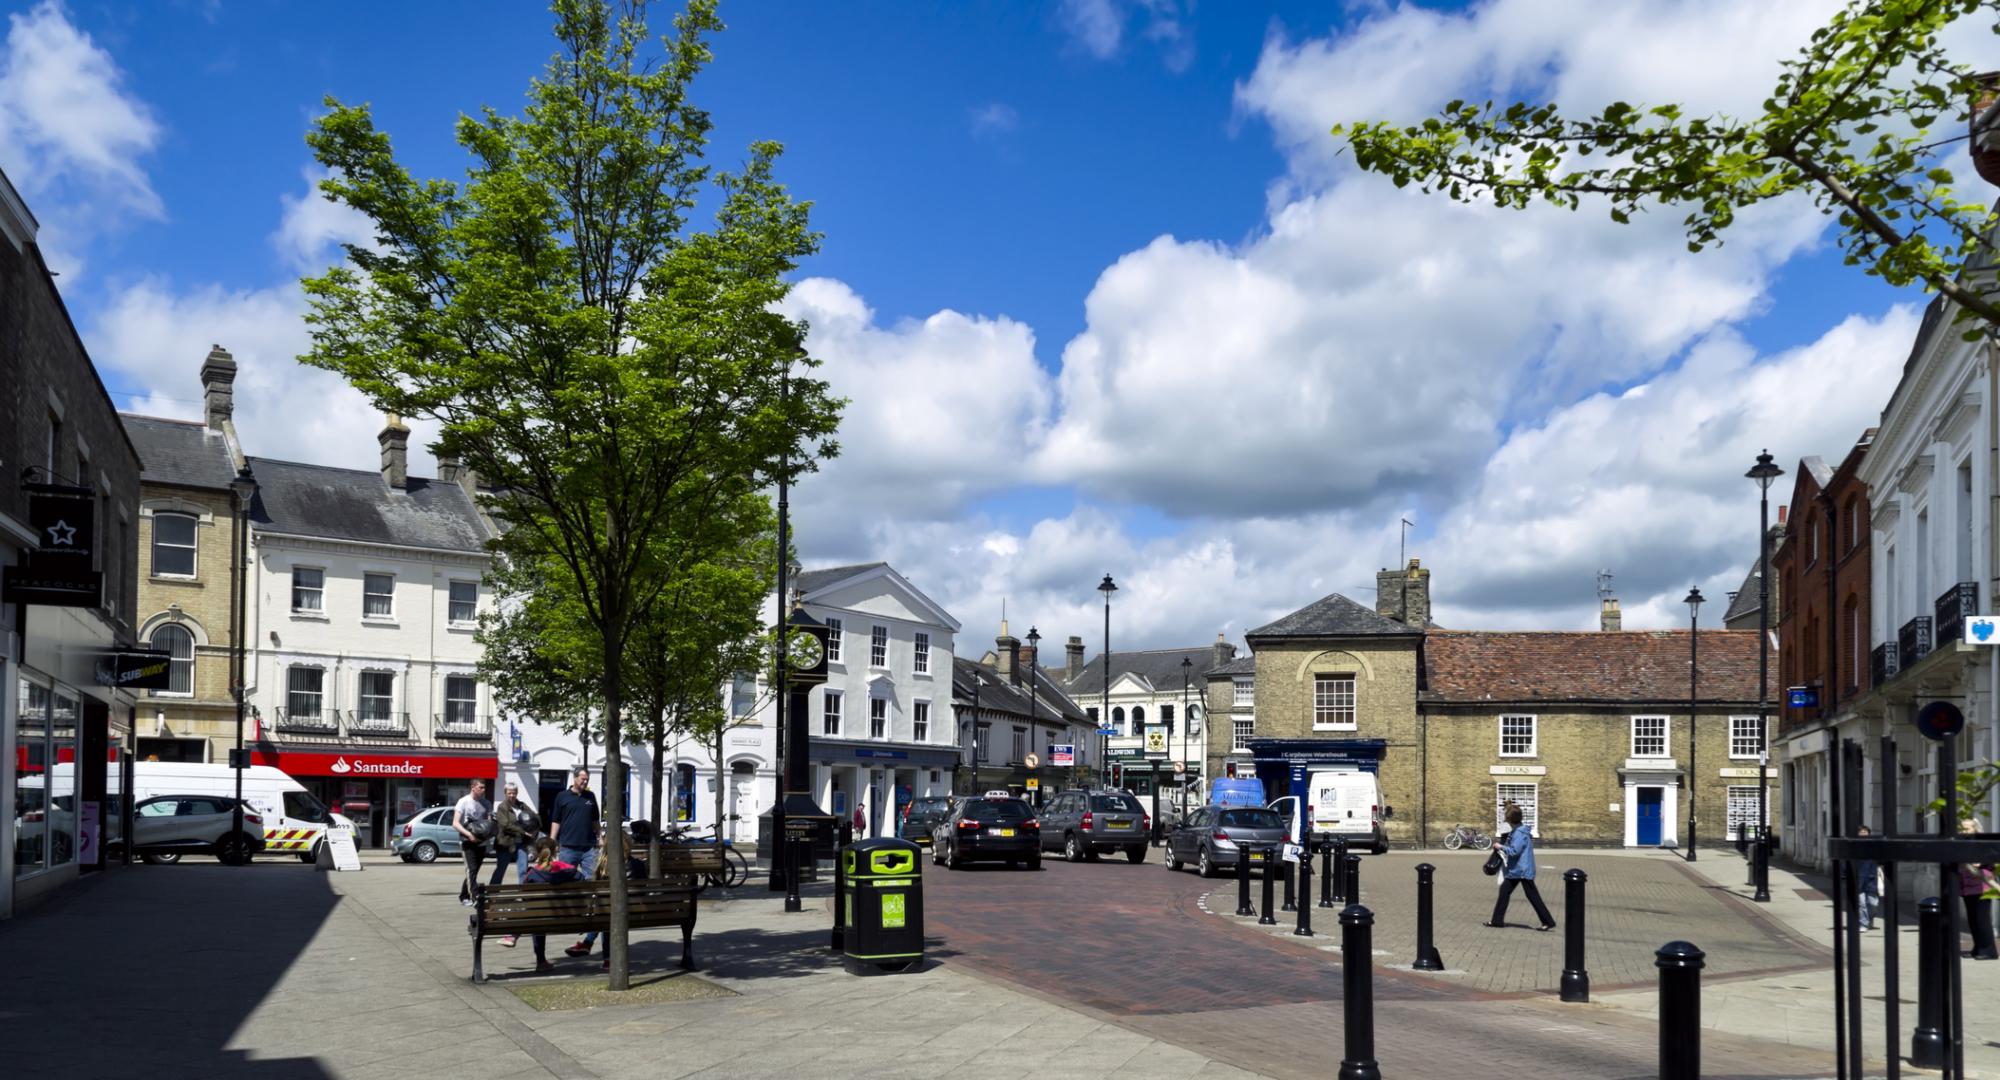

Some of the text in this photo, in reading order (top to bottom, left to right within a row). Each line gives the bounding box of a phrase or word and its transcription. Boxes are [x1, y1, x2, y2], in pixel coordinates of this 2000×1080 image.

[9, 578, 97, 590] PEACOCKS
[119, 661, 168, 683] SUBWAY
[353, 760, 424, 774] Santander
